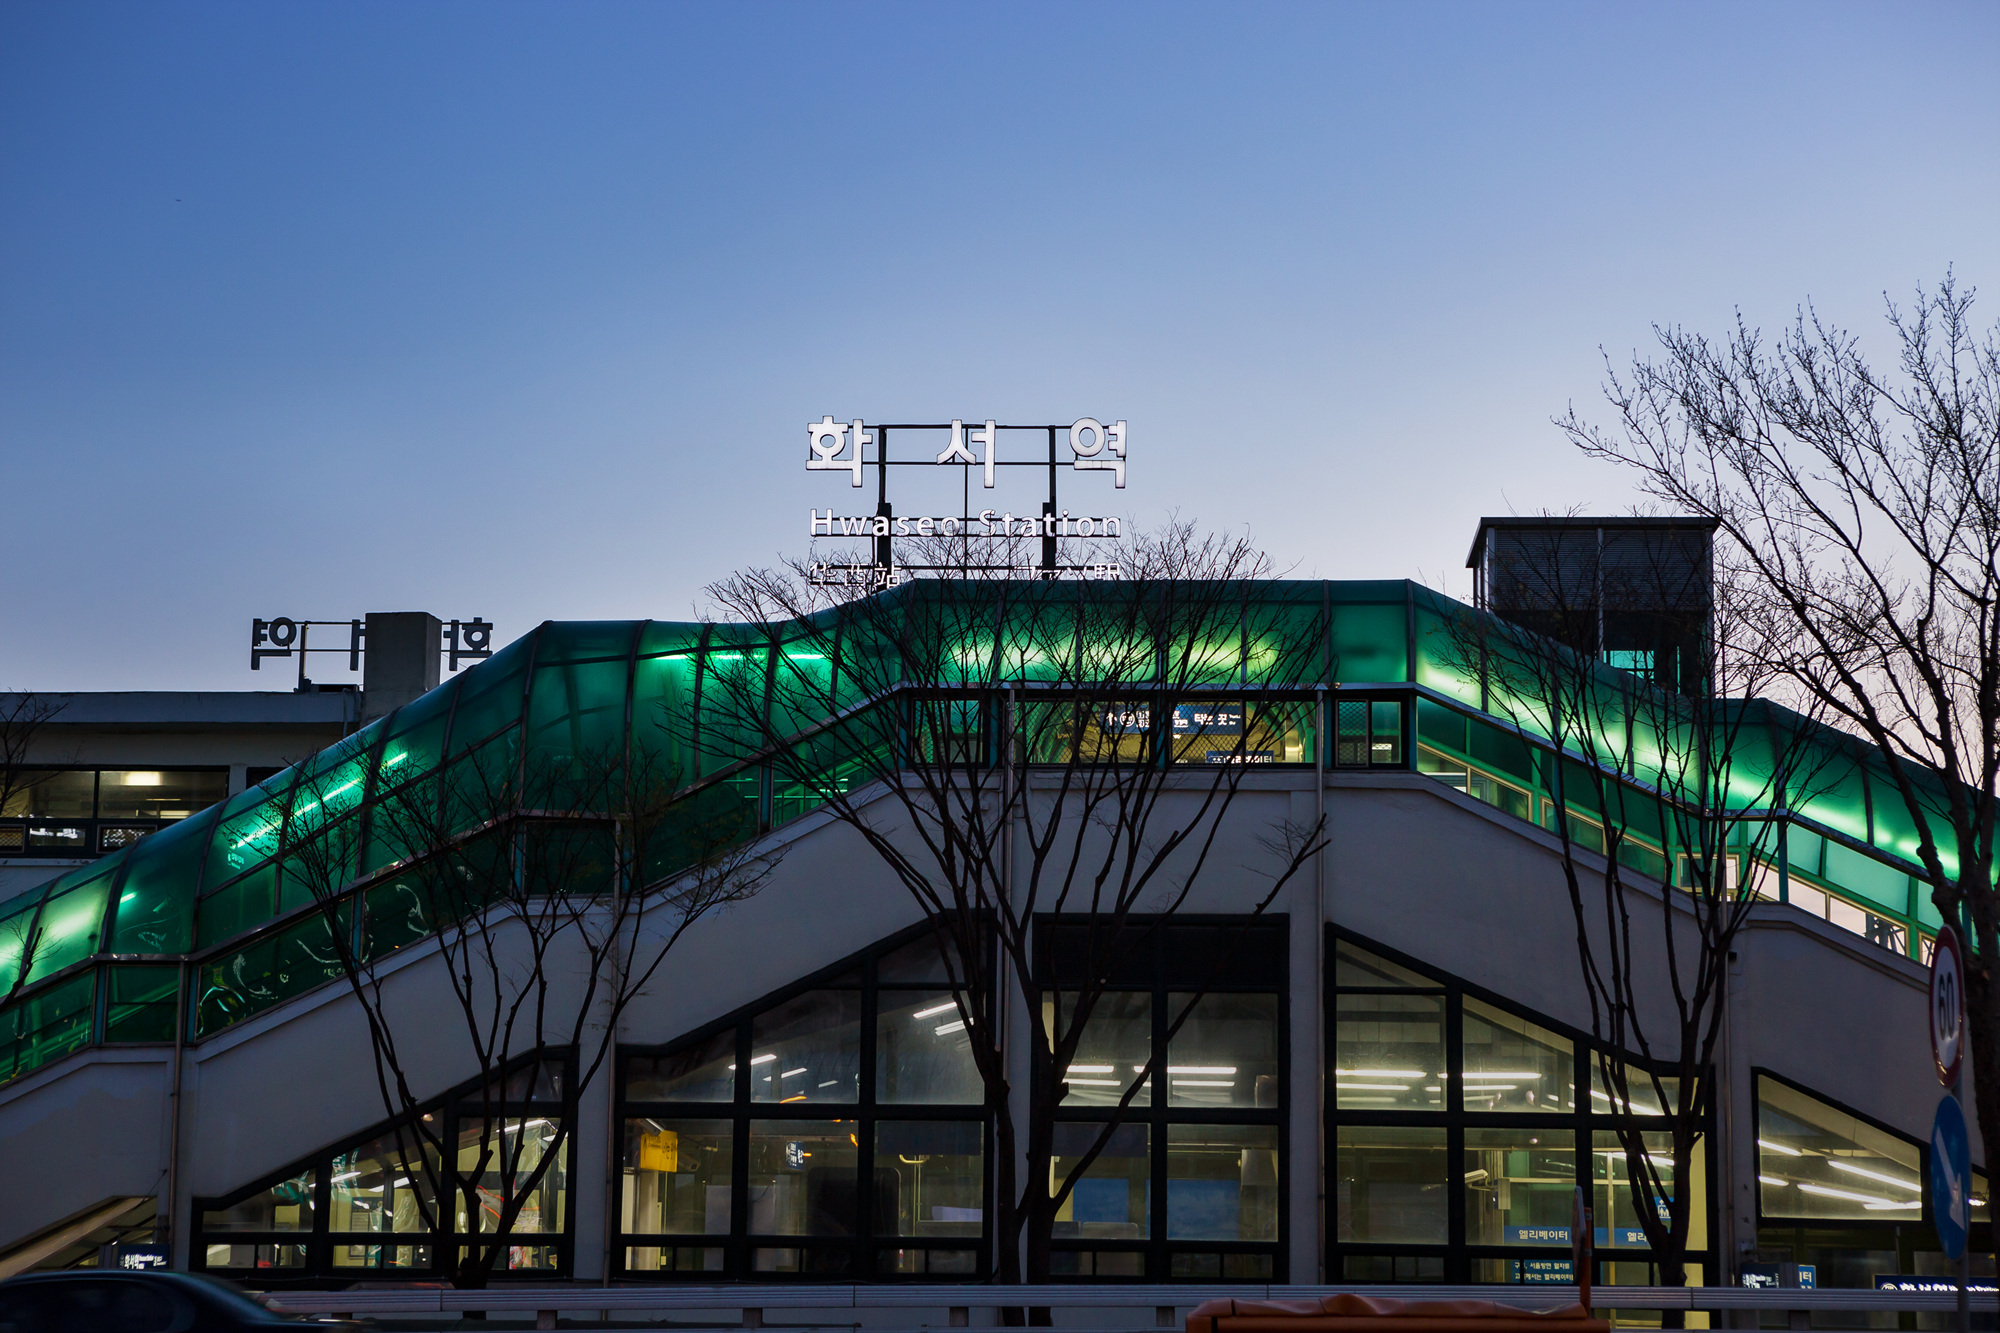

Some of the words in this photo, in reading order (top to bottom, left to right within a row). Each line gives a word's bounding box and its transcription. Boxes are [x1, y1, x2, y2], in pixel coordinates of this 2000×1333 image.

[810, 508, 960, 537] Hwaseo
[979, 509, 1121, 537] Station
[809, 562, 902, 589] 华西站
[1939, 971, 1955, 1041] 60
[1518, 1229, 1569, 1241] 엘리베이터
